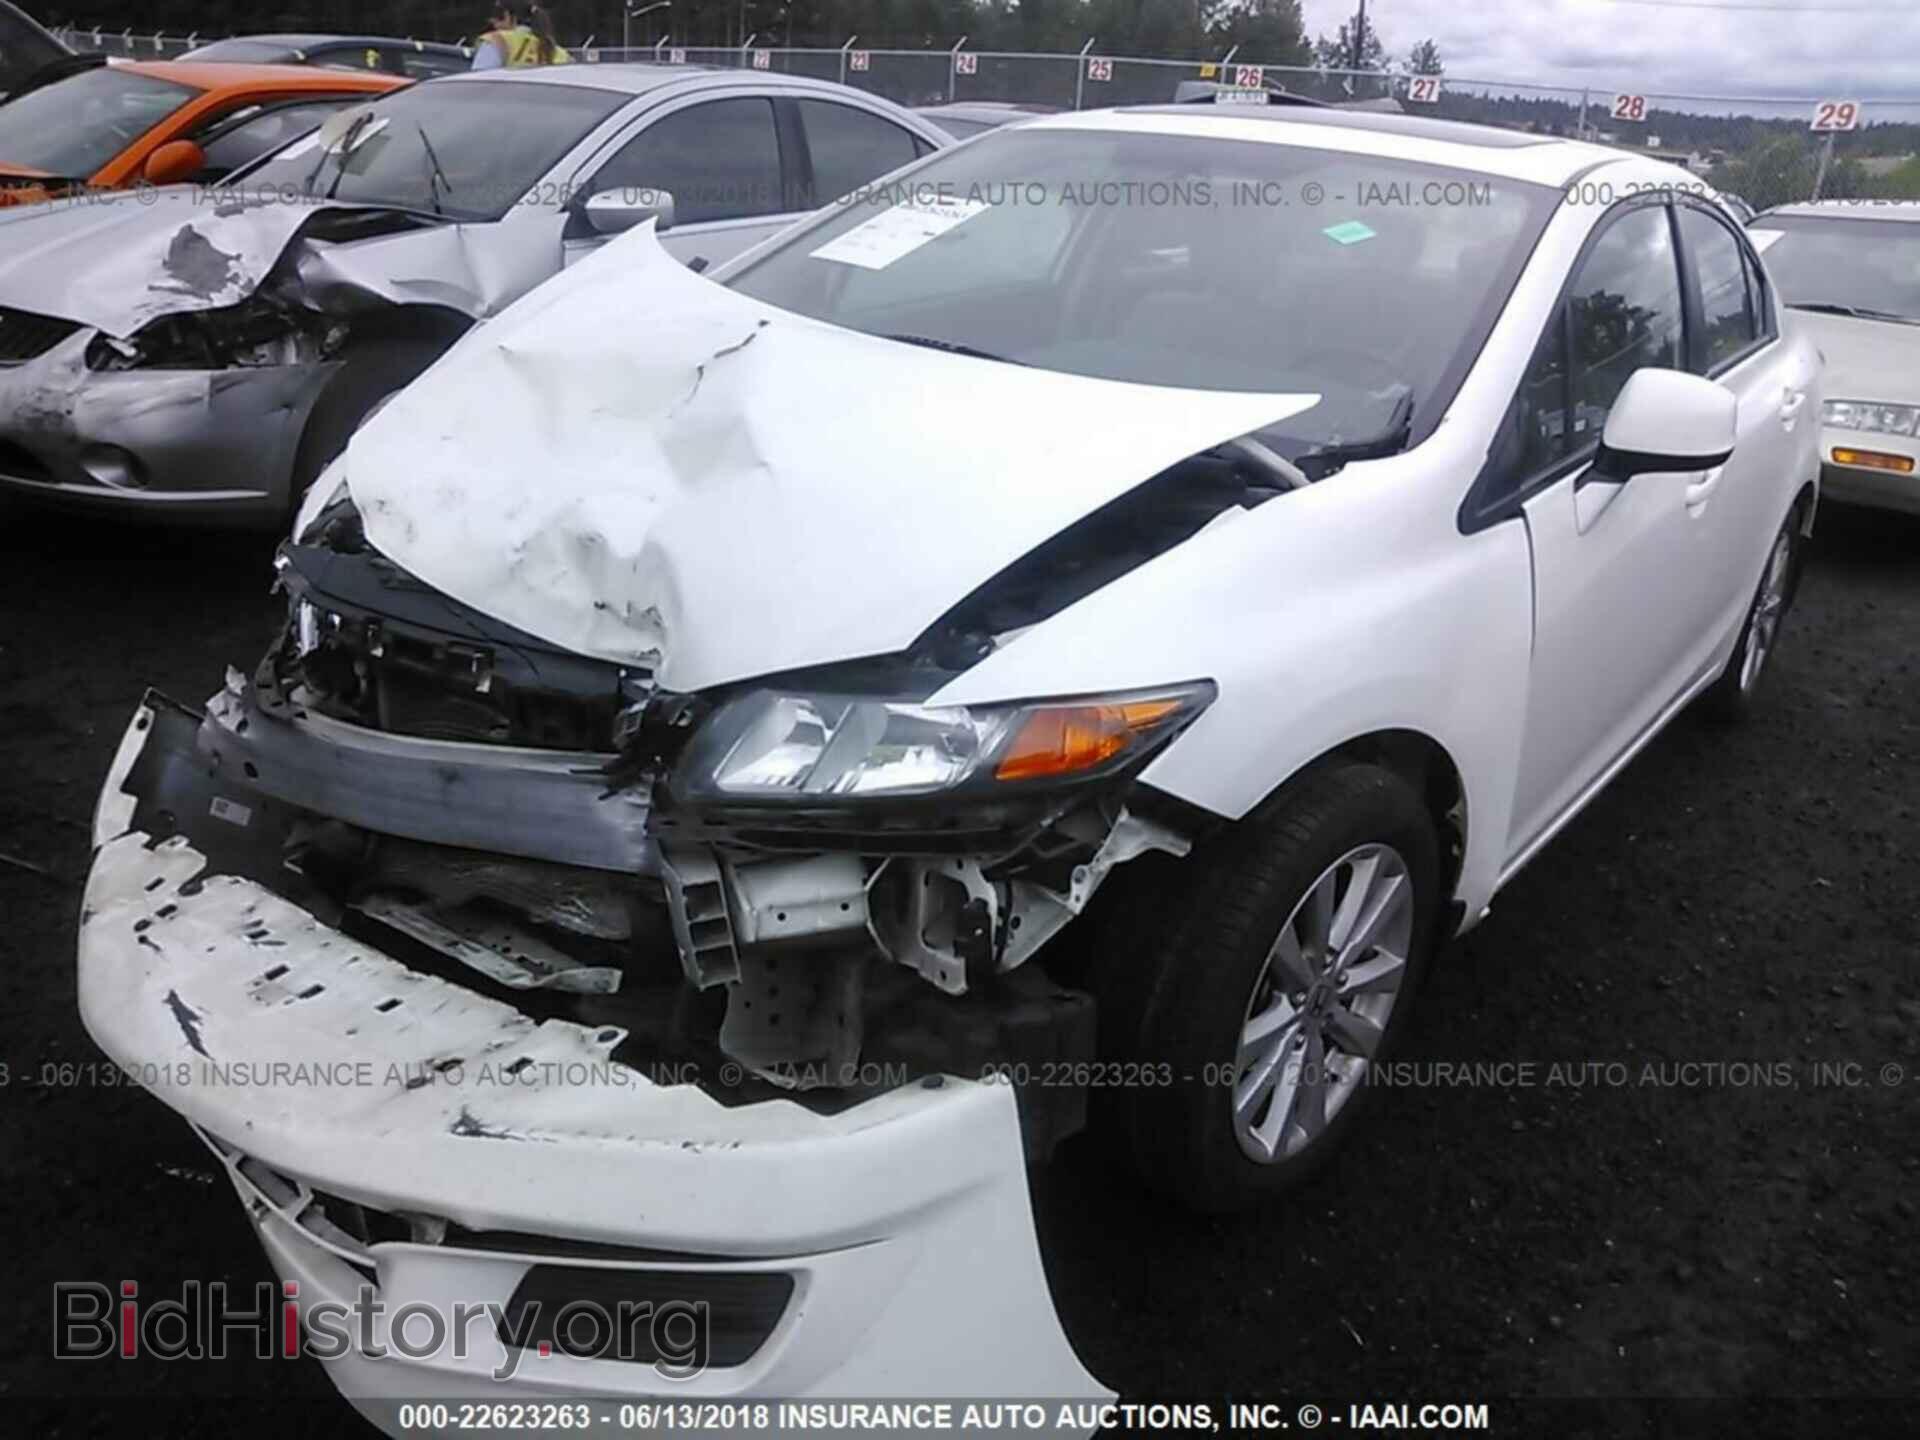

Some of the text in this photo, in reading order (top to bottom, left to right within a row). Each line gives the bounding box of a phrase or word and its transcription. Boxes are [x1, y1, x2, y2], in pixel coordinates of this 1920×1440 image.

[958, 56, 975, 72] 24
[1091, 61, 1109, 79] 25
[1238, 68, 1259, 87] 26
[1413, 79, 1436, 99] 27
[1615, 96, 1644, 118] 28
[1815, 103, 1856, 128] 29
